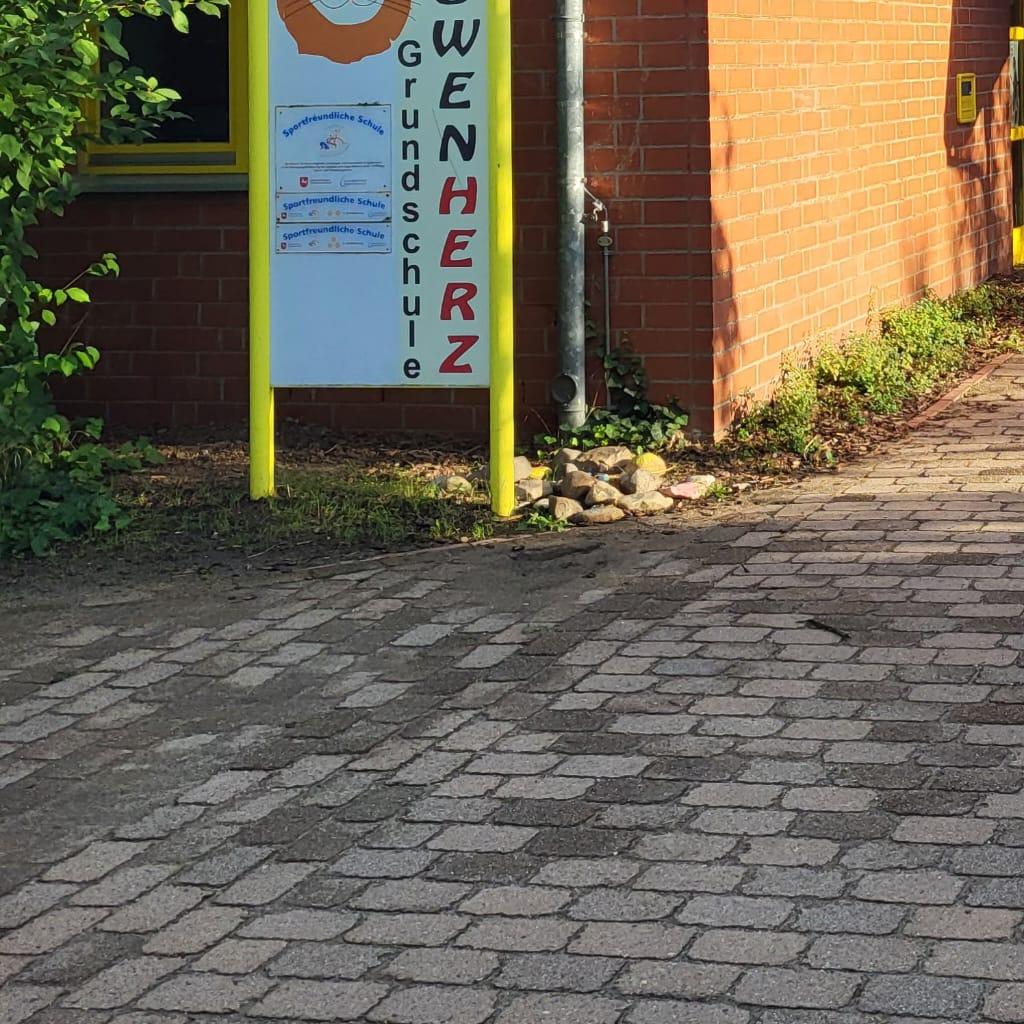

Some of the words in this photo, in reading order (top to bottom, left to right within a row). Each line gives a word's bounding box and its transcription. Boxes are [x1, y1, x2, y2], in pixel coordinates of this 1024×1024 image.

[282, 111, 355, 138] Sportfreundliche
[357, 115, 385, 137] Schule
[282, 195, 355, 211] Sportfreundliche
[357, 196, 386, 210] Schule
[397, 40, 422, 379] Grundschule
[282, 225, 355, 241] Sportfreundliche
[356, 226, 385, 240] Schule
